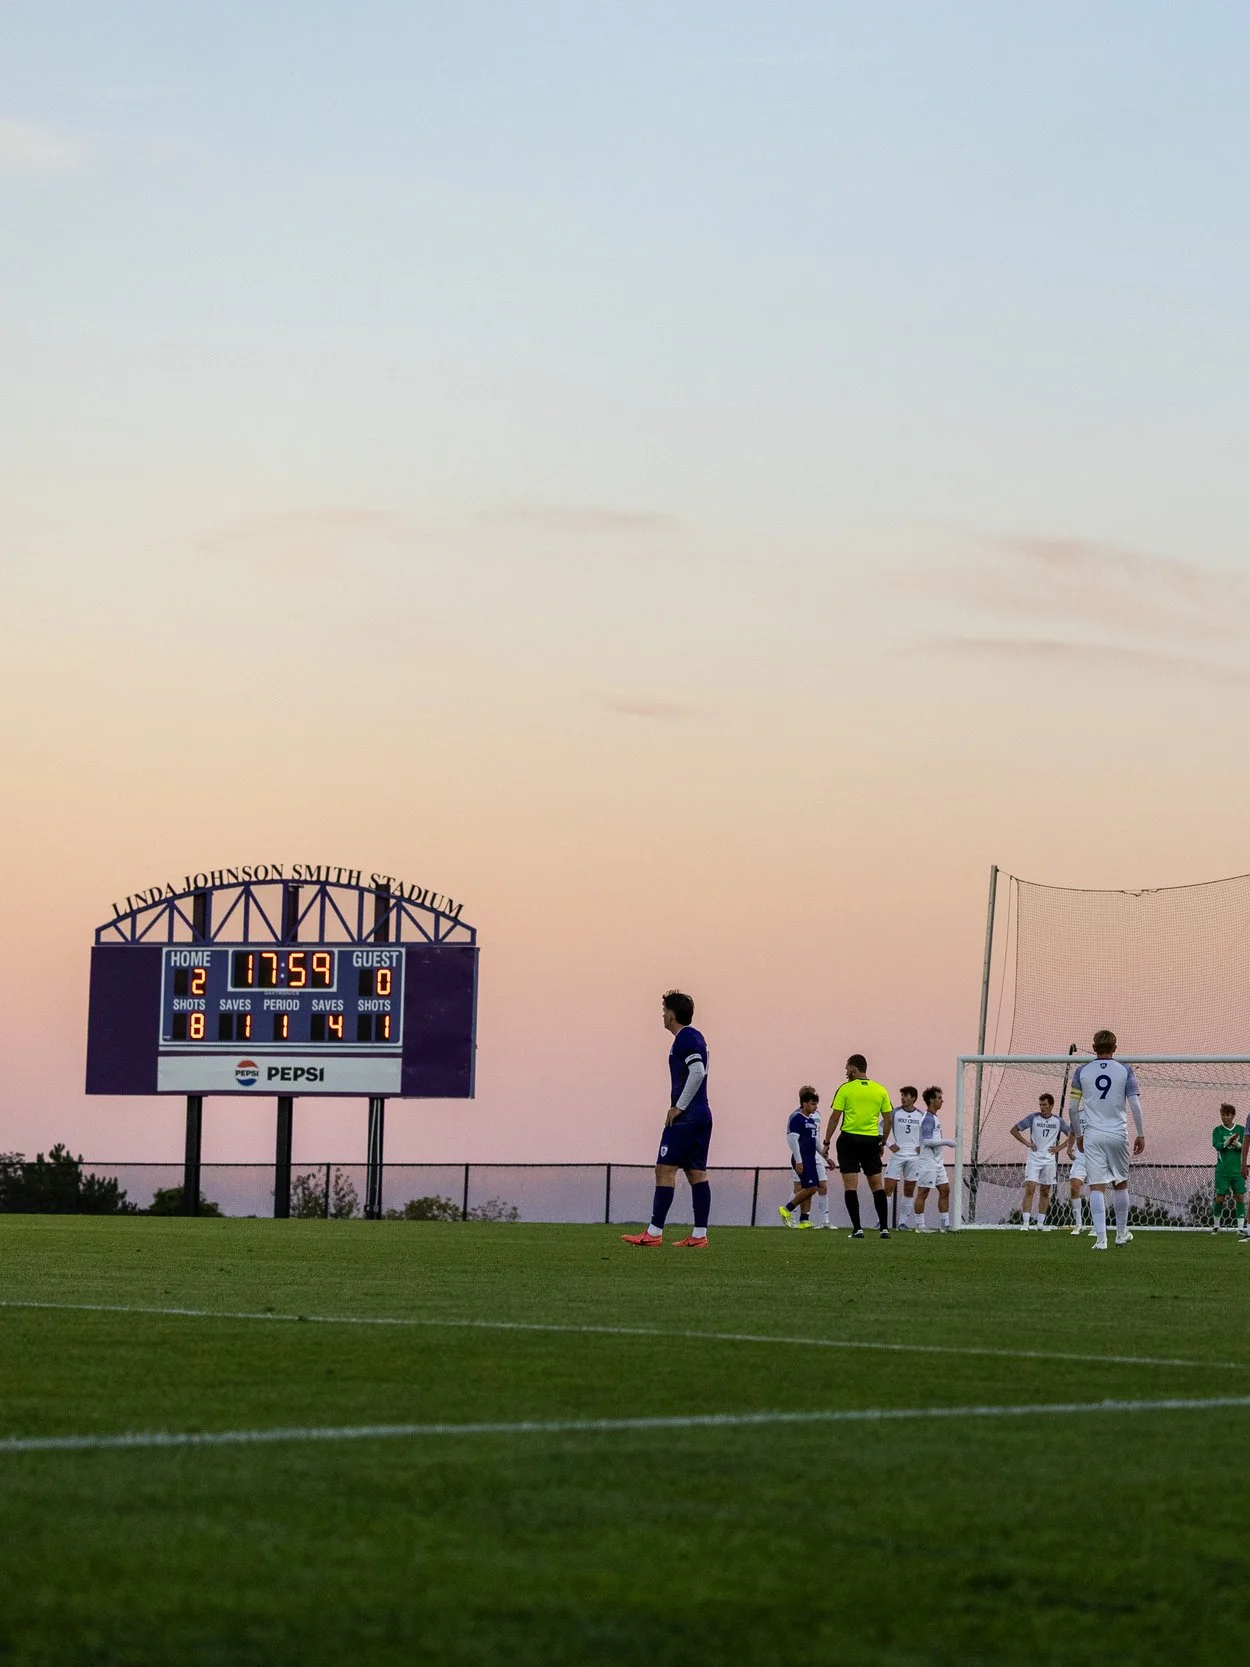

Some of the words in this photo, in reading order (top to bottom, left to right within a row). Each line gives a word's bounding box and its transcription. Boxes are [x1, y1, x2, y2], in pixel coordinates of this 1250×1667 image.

[111, 881, 178, 918] LINDA
[182, 863, 284, 893] JOHNSON
[292, 863, 362, 888] SMITH
[368, 872, 465, 920] STADIUM
[170, 951, 212, 967] HOME
[352, 951, 400, 968] GUEST
[247, 952, 331, 987] 17:59
[191, 968, 206, 995] 2
[376, 968, 392, 995] 0
[172, 999, 206, 1011] SHOTS
[219, 999, 252, 1011] SAVES
[263, 999, 301, 1011] PERIOD
[311, 999, 345, 1011] SAVES
[357, 999, 392, 1011] SHOTS
[190, 1013, 205, 1039] 8
[244, 1014, 252, 1038] 1
[282, 1014, 289, 1038] 1
[328, 1014, 344, 1039] 4
[383, 1014, 391, 1039] 1
[235, 1069, 260, 1077] PEPSI
[267, 1066, 325, 1082] PEPSI
[1094, 1074, 1113, 1100] 9
[905, 1124, 912, 1134] 3
[1042, 1129, 1051, 1138] 17
